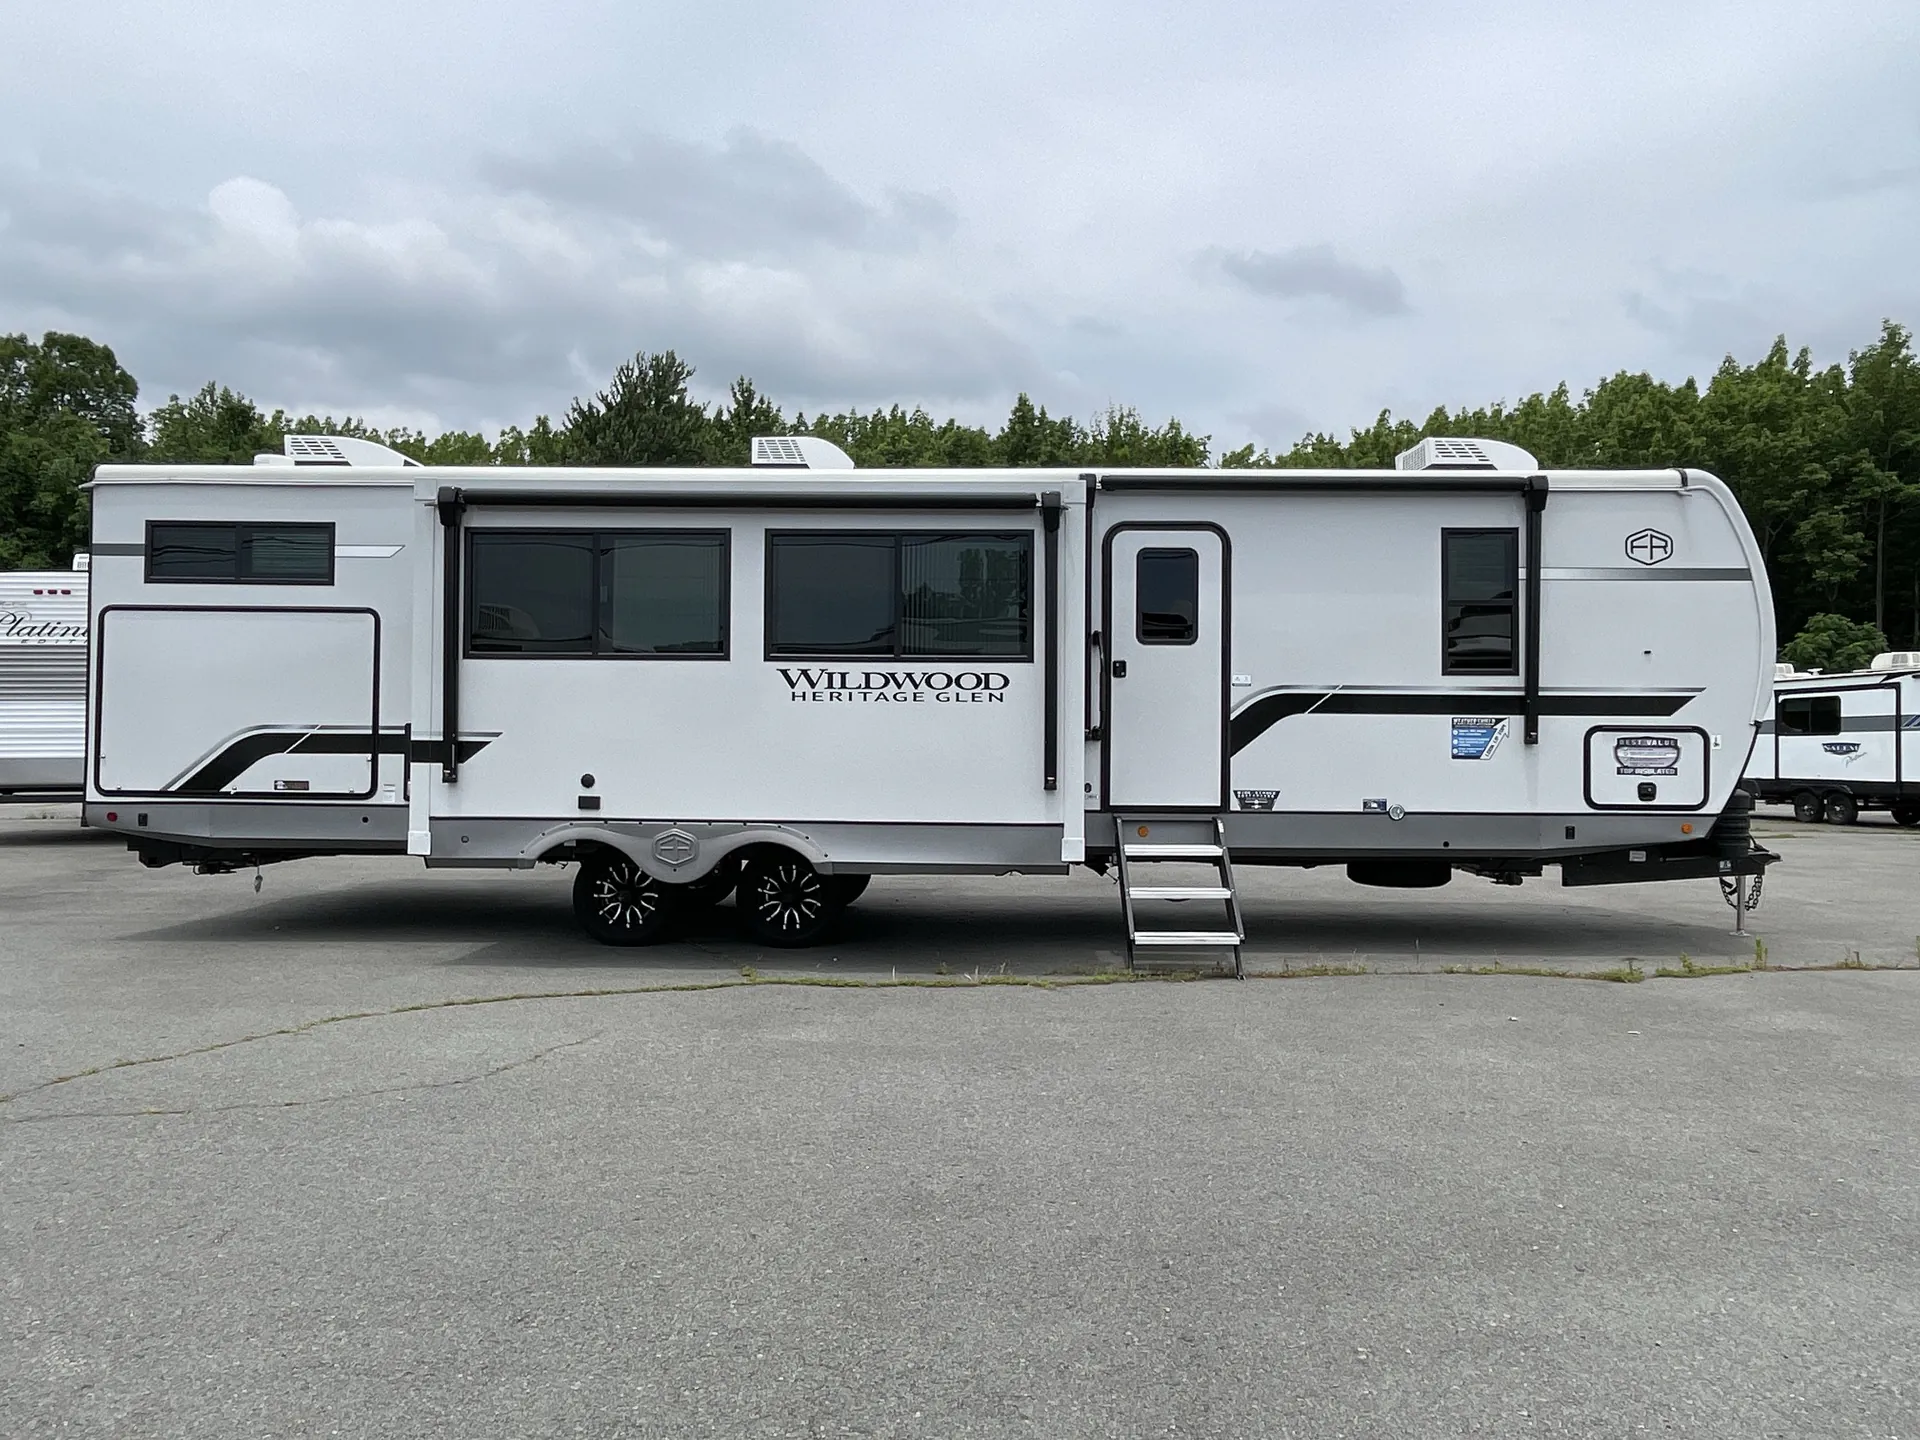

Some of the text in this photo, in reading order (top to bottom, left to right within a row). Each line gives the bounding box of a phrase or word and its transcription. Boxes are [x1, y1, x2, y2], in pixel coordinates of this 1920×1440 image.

[776, 668, 1010, 691] WILDWOOD
[791, 691, 1004, 703] HERITAGE GLEN
